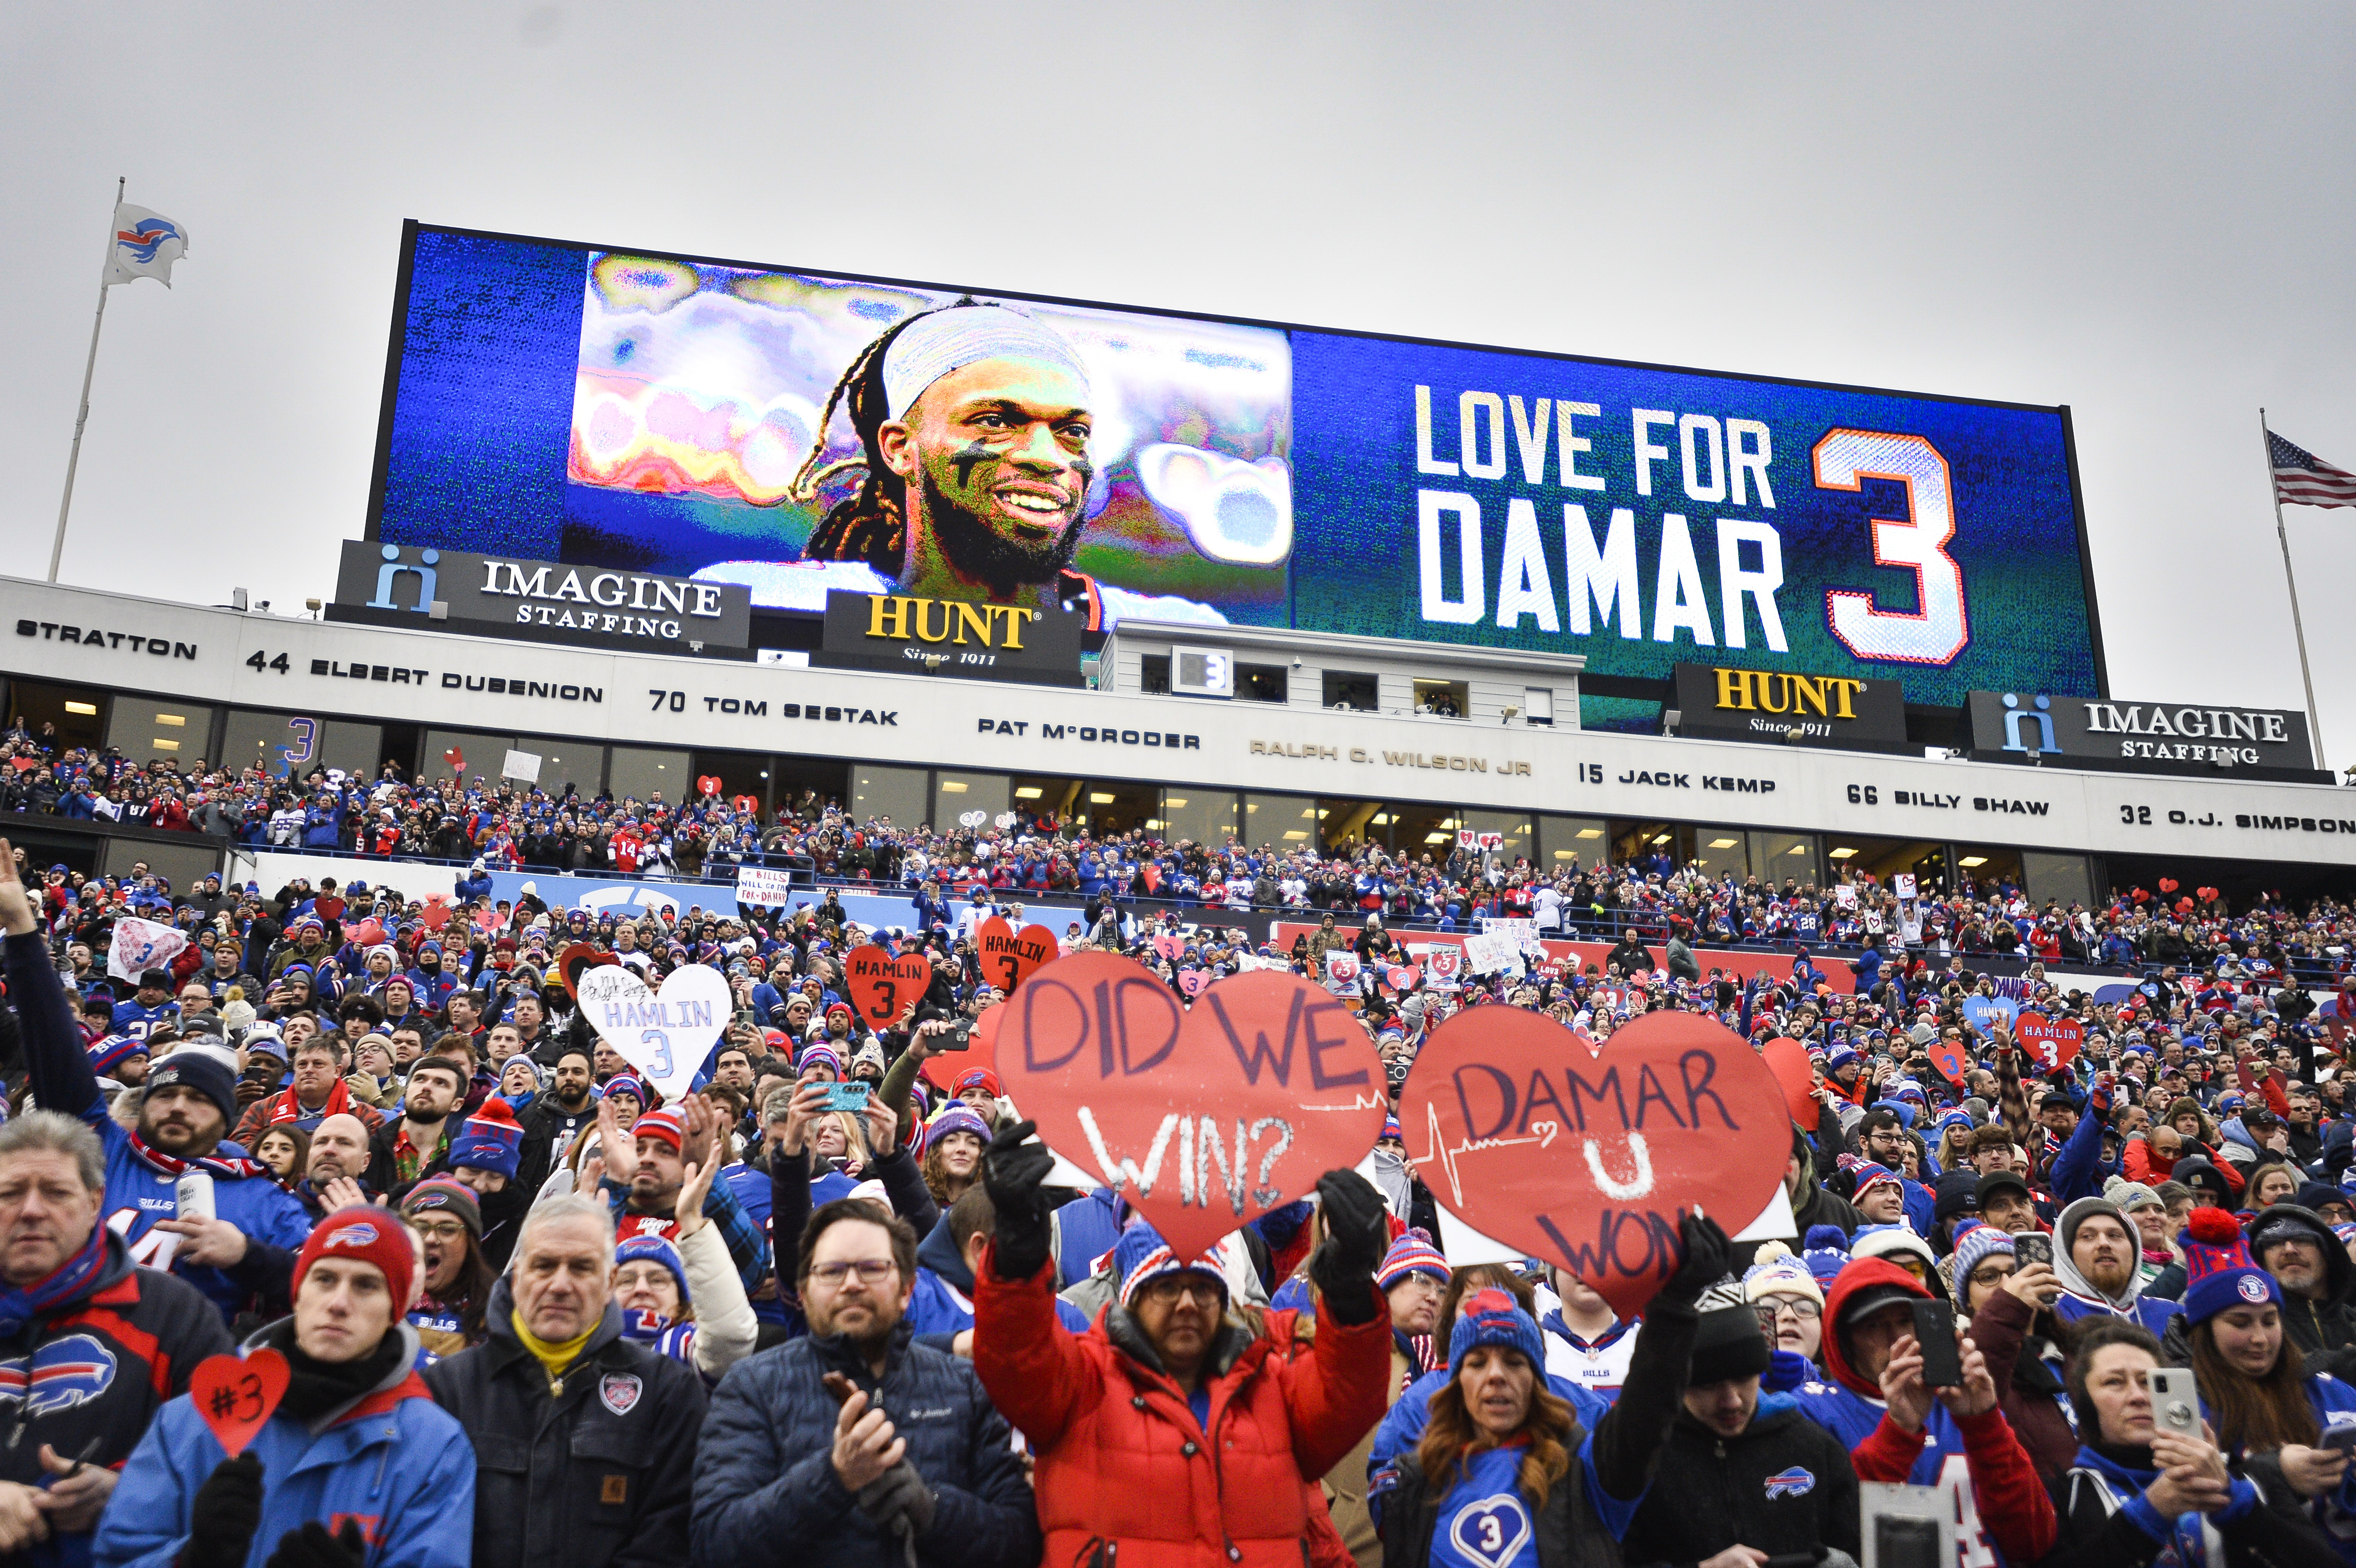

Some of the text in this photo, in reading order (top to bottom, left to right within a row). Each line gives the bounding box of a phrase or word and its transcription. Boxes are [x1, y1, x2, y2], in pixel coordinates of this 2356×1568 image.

[1415, 384, 1776, 508] LOVE FOR
[1811, 427, 1969, 666] 3
[1417, 489, 1789, 654] DAMAR
[480, 560, 722, 618] IMAGINE
[516, 604, 682, 639] STAFFING
[16, 620, 197, 660] STRATTON
[960, 652, 995, 666] 1911
[1206, 654, 1225, 689] 3
[247, 650, 603, 703] 44 ELBERT DUBENION
[649, 689, 898, 726] 70 TOM SESTAK
[978, 718, 1200, 749] PAT McGRODER
[1749, 718, 1831, 738] Since 1911
[2084, 703, 2288, 743] IMAGINE
[284, 717, 316, 762] 3
[1251, 740, 1532, 775] RALPH C. WILSON JR
[2121, 741, 2259, 765] STAFFING
[324, 769, 346, 790] 3
[706, 781, 714, 793] 3
[1580, 762, 1775, 793] 15 JACK KEMP
[744, 799, 750, 812] 3
[1847, 784, 2049, 816] 66 BILLY SHAW
[2120, 805, 2356, 834] 32 O.J. SIMPSON
[620, 842, 636, 858] 14
[757, 871, 786, 883] BILLS
[742, 890, 786, 903] FOR DAMAR
[1516, 895, 1526, 904] 17
[486, 915, 495, 927] 3
[1801, 918, 1816, 930] 28
[985, 936, 1046, 962] HAMLIN
[1100, 938, 1116, 951] 12
[1165, 943, 1175, 958] 3
[855, 960, 923, 980] HAMLIN
[996, 955, 1018, 994] 3
[1335, 963, 1351, 977] #3
[1435, 957, 1451, 971] #3
[1540, 966, 1559, 975] LOV3
[1186, 977, 1198, 992] 3
[1397, 972, 1410, 990] 3
[870, 981, 896, 1019] 3
[1606, 991, 1617, 1007] 3
[604, 1000, 712, 1028] HAMLIN
[1976, 1007, 2008, 1018] HAMLIN
[1023, 978, 1369, 1091] DID WE
[2024, 1026, 2077, 1040] HAMLIN
[641, 1029, 674, 1079] 3
[1943, 1054, 1959, 1075] 3
[2038, 1040, 2059, 1067] 3
[1452, 1049, 1740, 1141] DAMAR
[1077, 1104, 1293, 1216] WIN?
[1583, 1131, 1654, 1201] U
[139, 1197, 175, 1211] BILLS
[419, 1317, 457, 1332] BILLS
[210, 1373, 264, 1423] #3
[1478, 1514, 1503, 1552] 3
